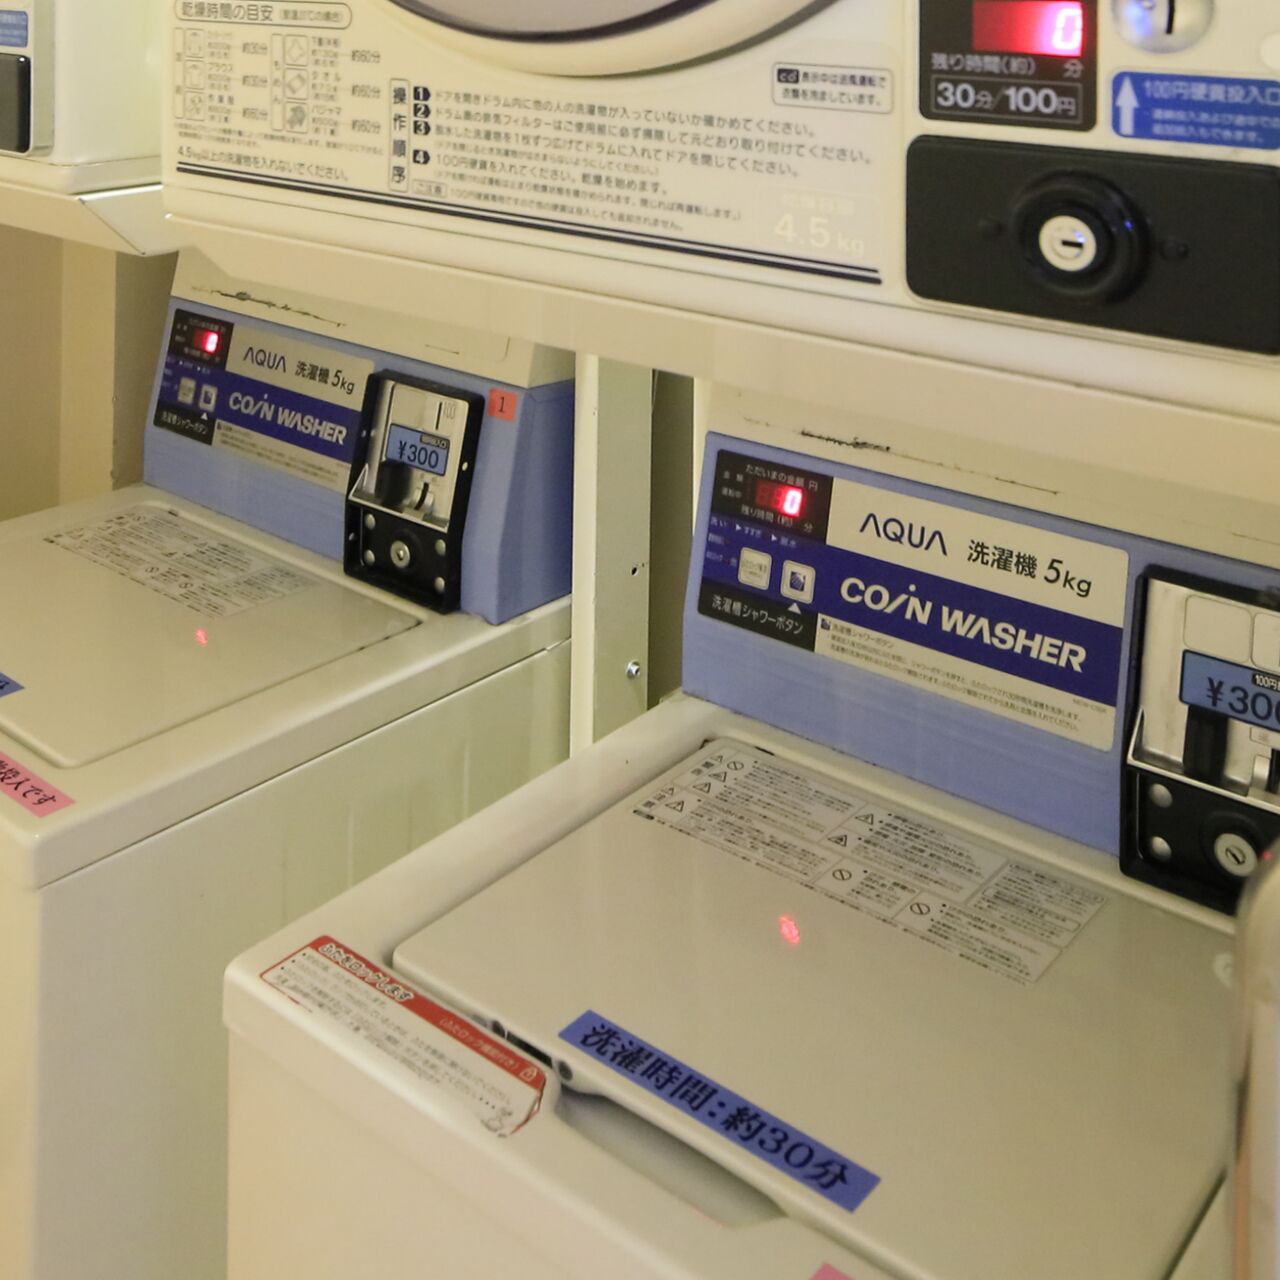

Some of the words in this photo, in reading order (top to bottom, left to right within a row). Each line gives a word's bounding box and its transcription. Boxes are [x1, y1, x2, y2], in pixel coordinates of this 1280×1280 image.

[181, 0, 274, 23] 乾燥時間の目安
[1052, 7, 1083, 50] 0
[1064, 59, 1084, 78] 分
[393, 86, 407, 183] 操作順序
[243, 346, 287, 374] AQUA
[295, 360, 330, 384] 洗濯機
[497, 395, 506, 413] 1
[277, 407, 348, 446] WASHER
[398, 440, 439, 469] ¥300
[784, 488, 802, 516] 0
[859, 512, 948, 557] AQUA
[967, 539, 1038, 581] 洗濯機
[1044, 558, 1093, 598] 5kg
[711, 594, 804, 635] 洗濯槽シャワーボタン
[941, 605, 1089, 673] WASHER
